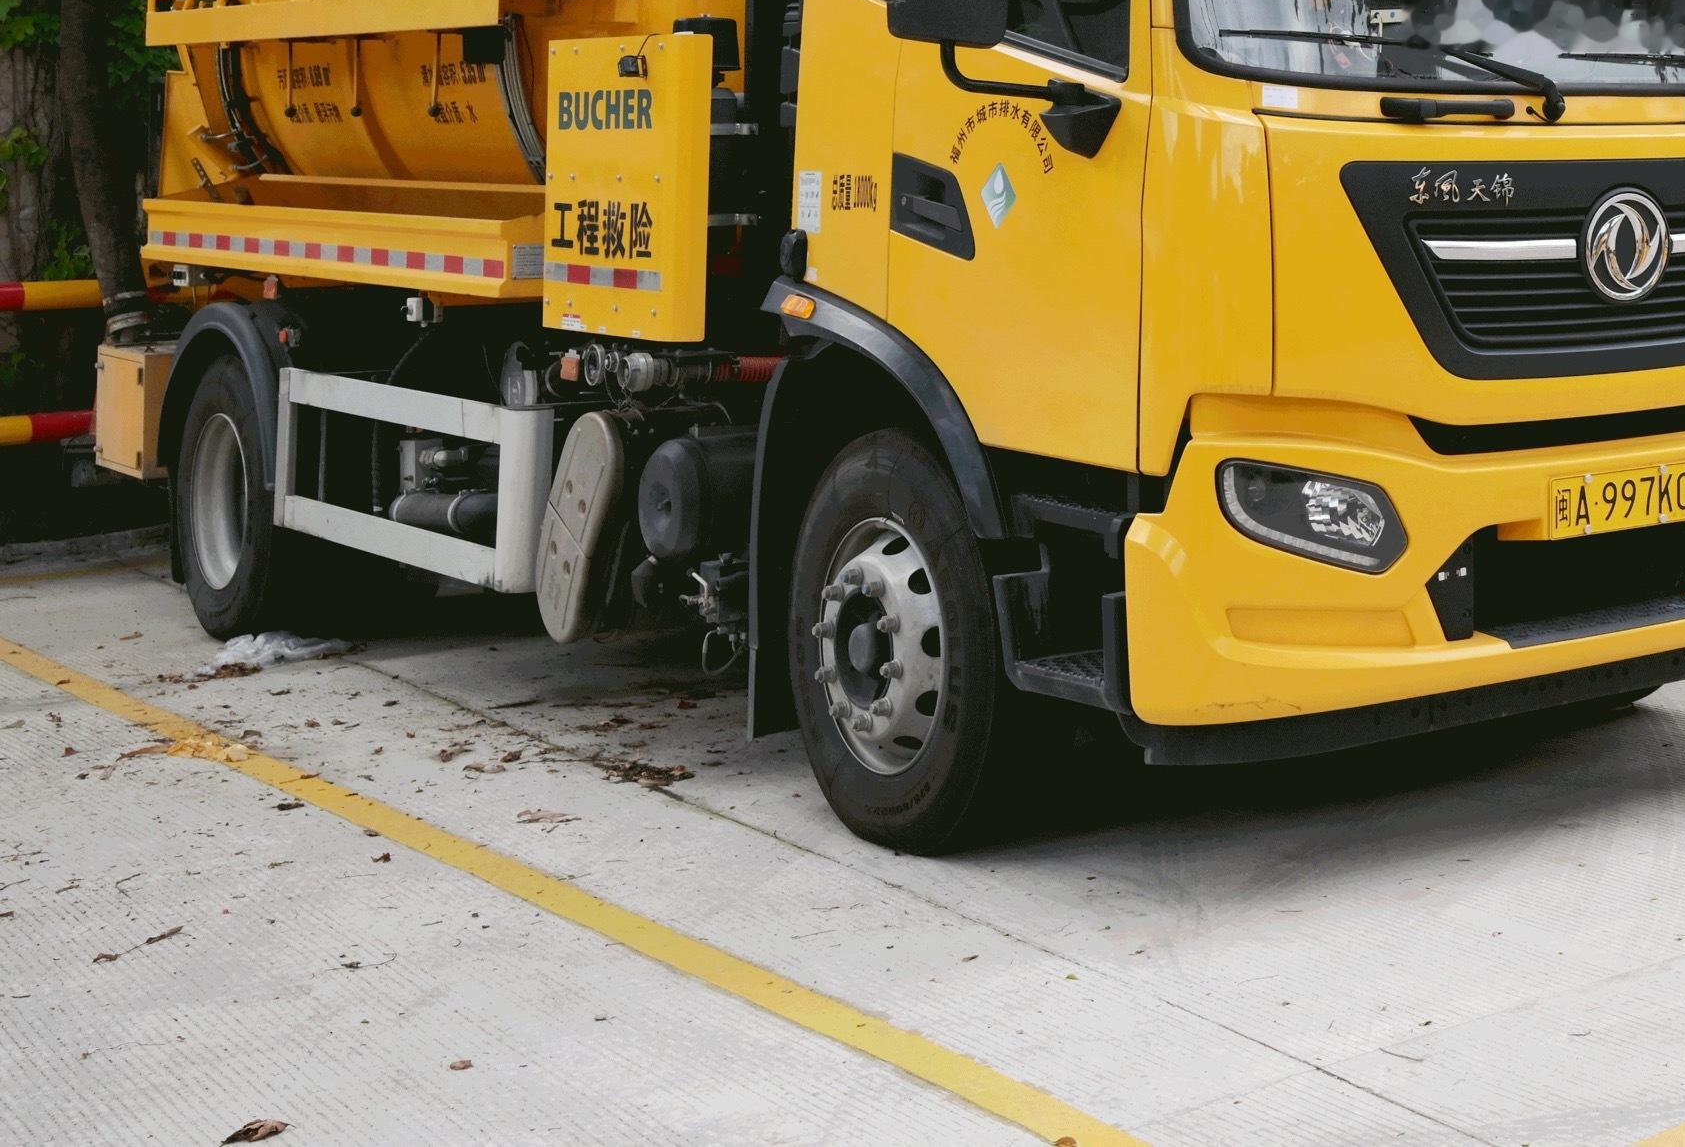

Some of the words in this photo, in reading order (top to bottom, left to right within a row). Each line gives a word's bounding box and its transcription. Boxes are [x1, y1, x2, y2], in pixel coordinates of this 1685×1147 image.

[558, 89, 653, 130] BUCHER
[949, 99, 1054, 174] 福州市城市排水有限公司
[551, 199, 653, 258] 工程救险
